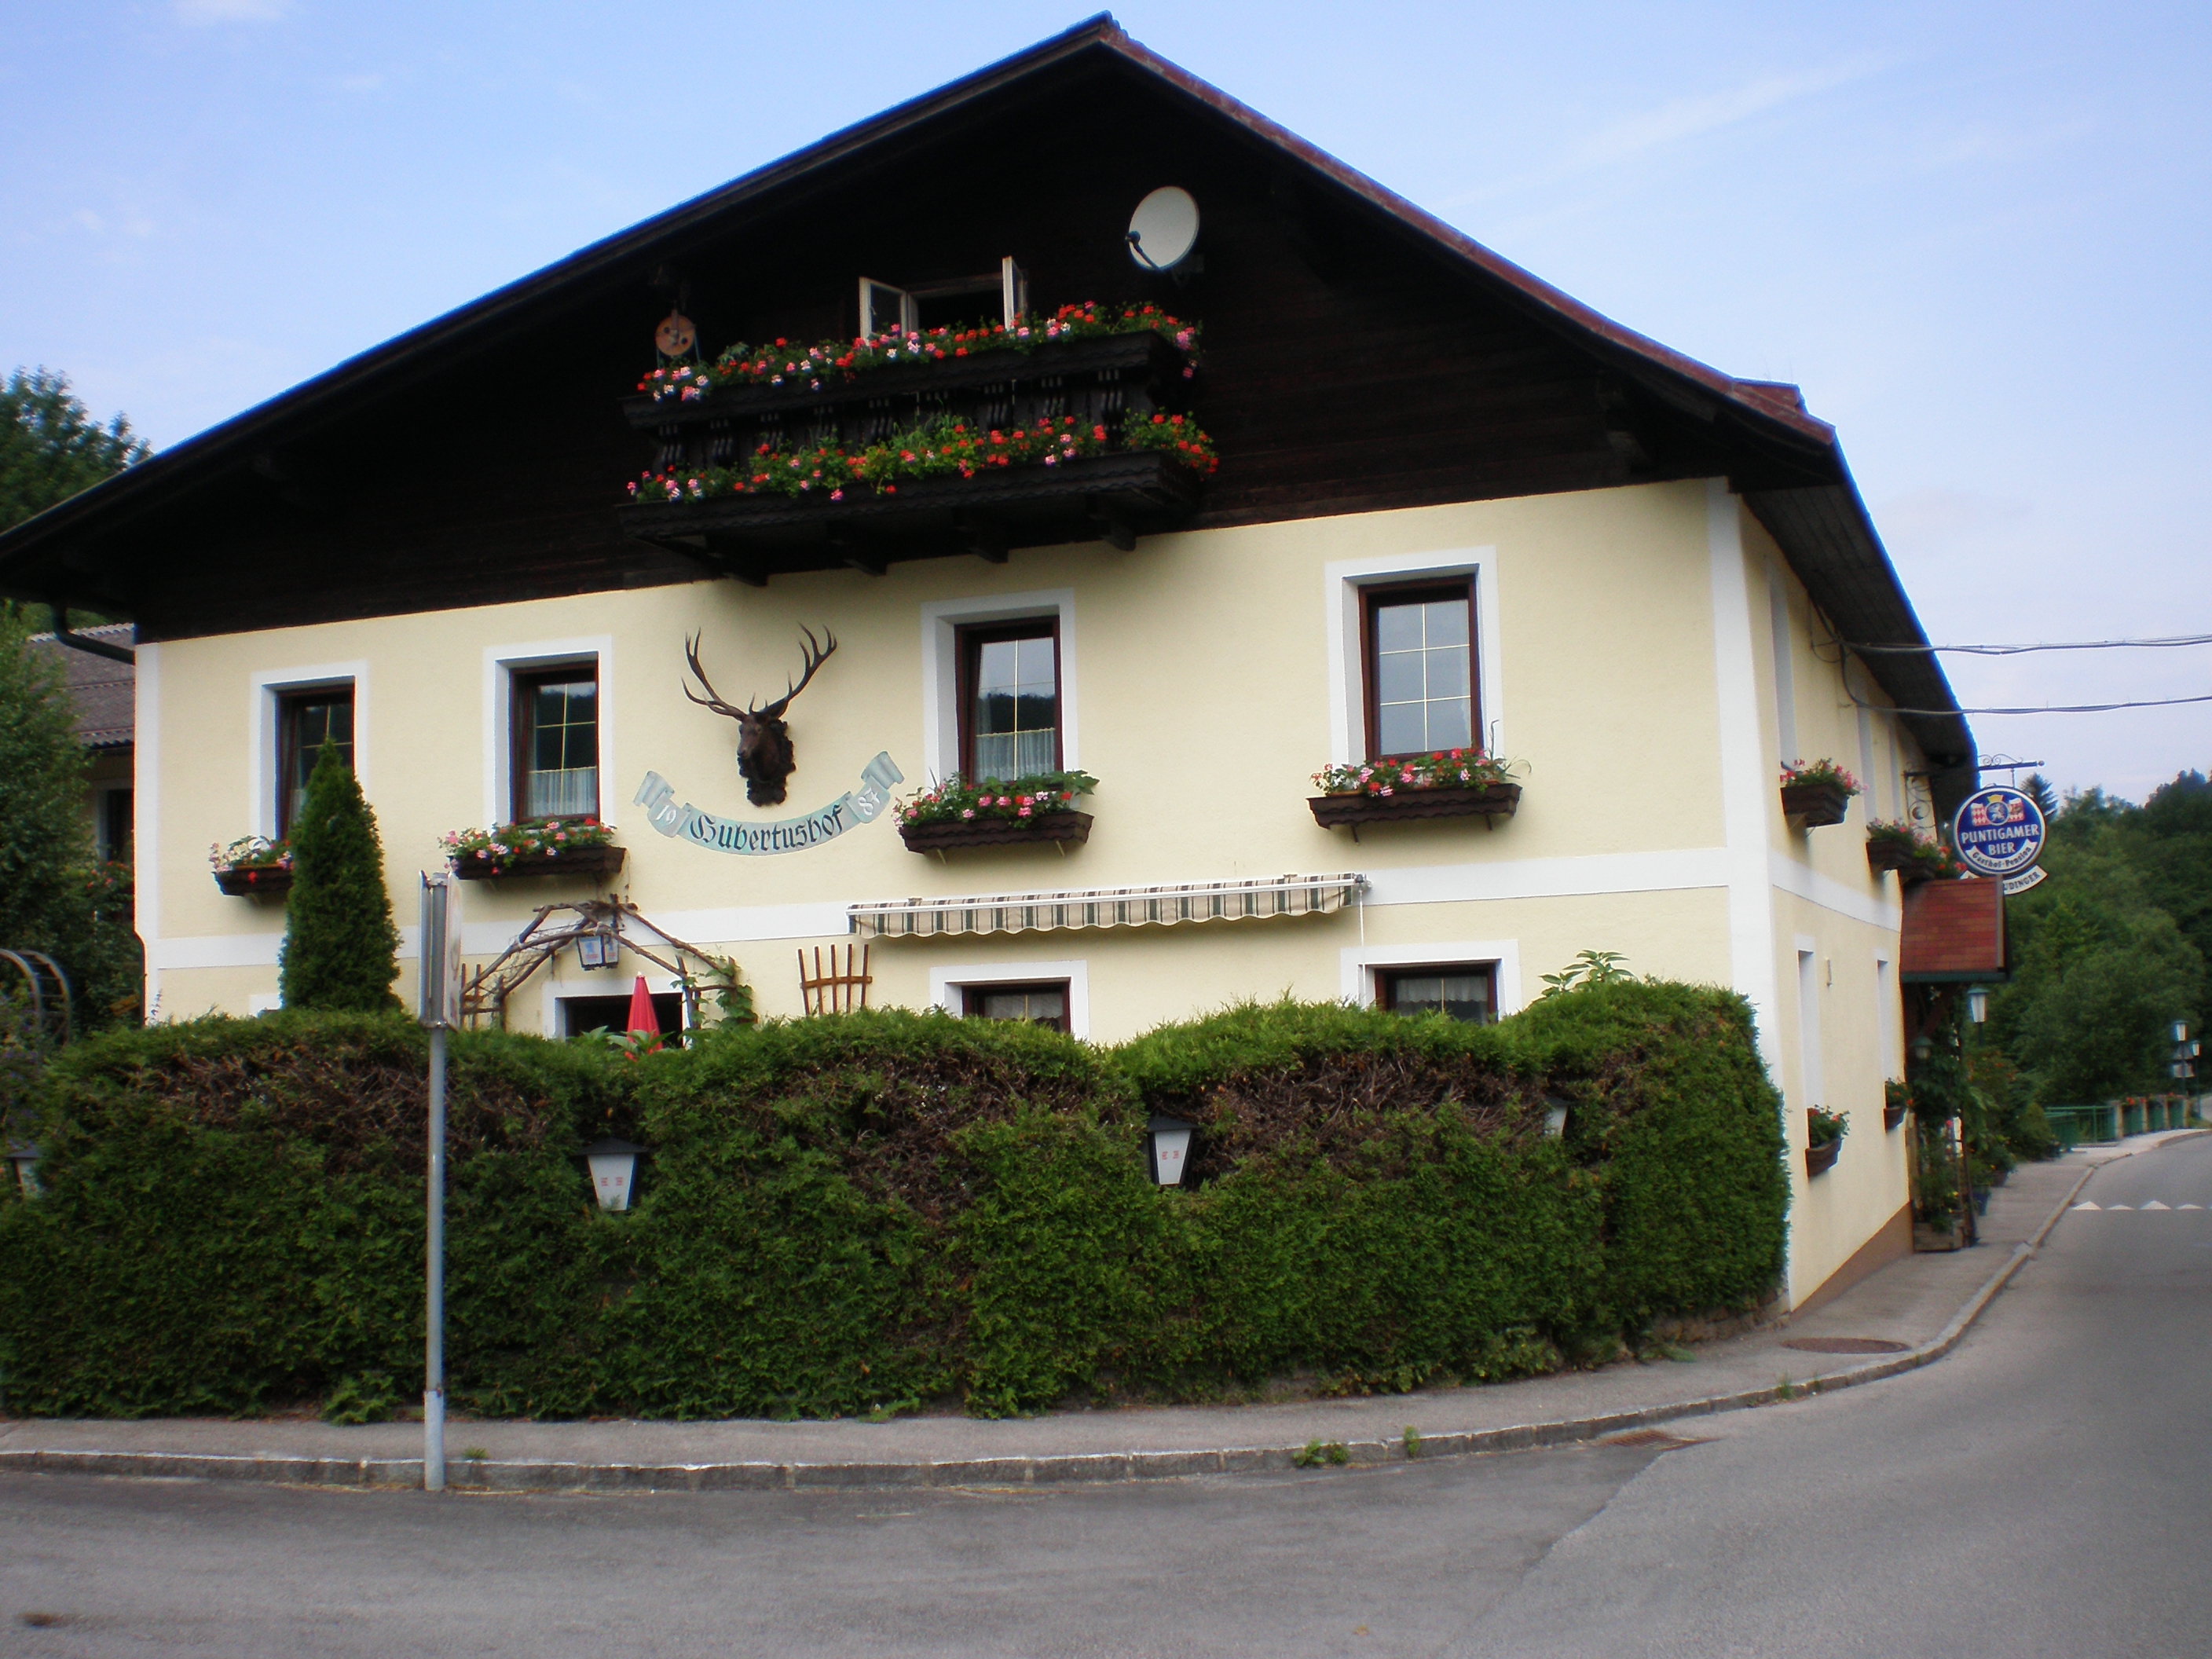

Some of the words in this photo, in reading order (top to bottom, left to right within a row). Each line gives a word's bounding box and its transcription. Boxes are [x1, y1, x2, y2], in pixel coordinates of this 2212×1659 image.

[655, 804, 676, 825] 19
[690, 804, 844, 851] Hubertushof
[857, 787, 881, 816] 87
[1961, 824, 2039, 844] PUNTIGAMER
[1989, 841, 2016, 855] BIER
[2004, 872, 2040, 891] UDINGER
